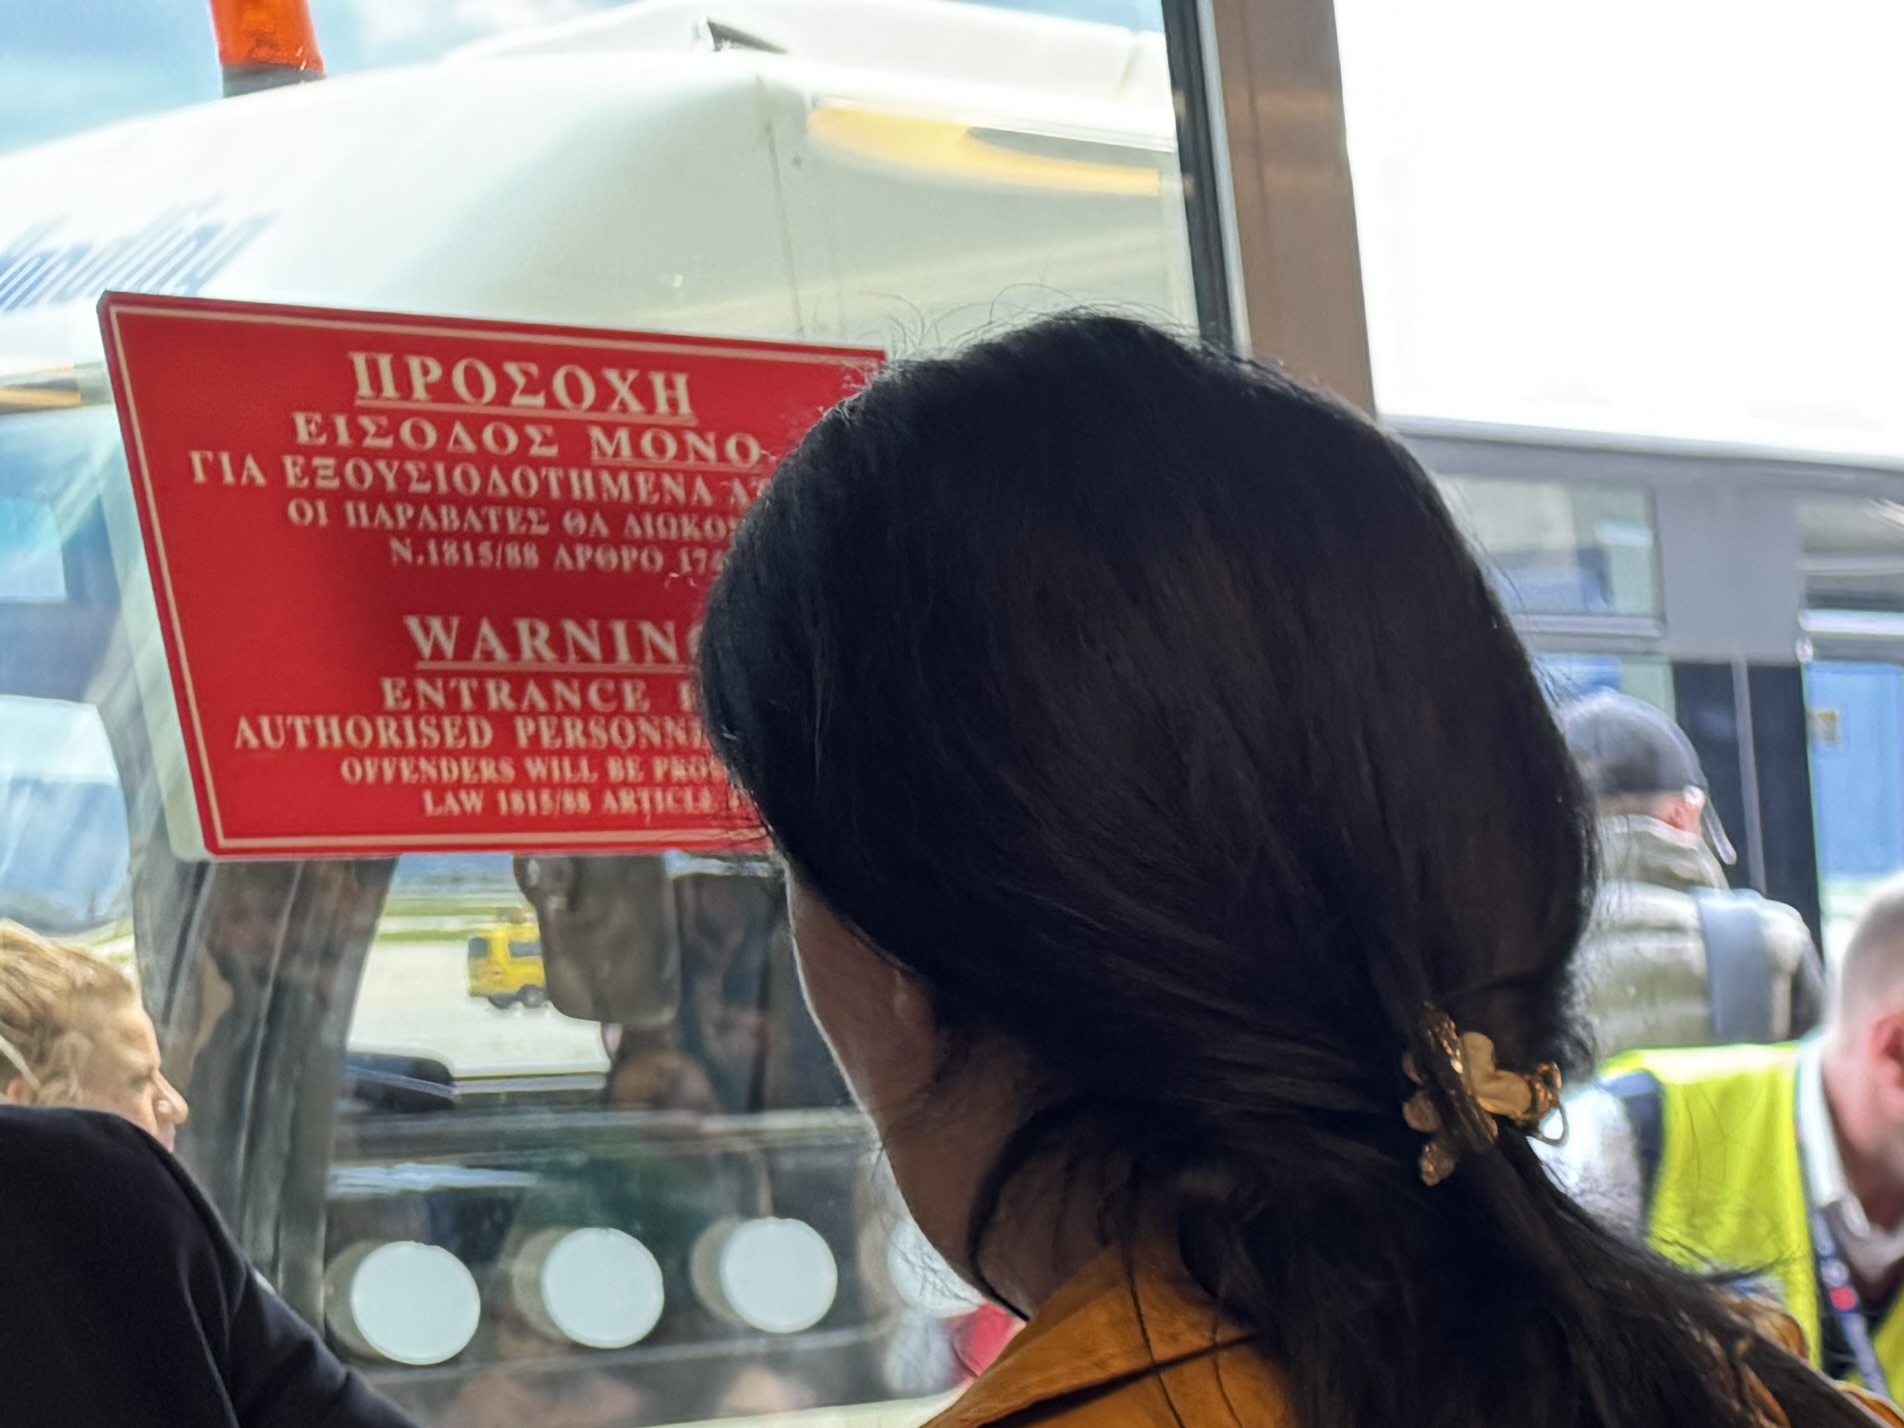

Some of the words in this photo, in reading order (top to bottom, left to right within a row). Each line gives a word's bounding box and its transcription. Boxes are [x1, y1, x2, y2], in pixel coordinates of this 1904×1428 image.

[348, 351, 693, 416] ΠΡΟΣΟΧΗ
[292, 411, 559, 457] ΕΙΣΟΔΟΣ
[588, 425, 762, 468] ΜΟΝΟ
[189, 450, 267, 486] ΓΙΑ
[281, 454, 713, 507] ΕΞΟΥΣΙΟΔΟΤΗΜΕΝΑ
[287, 499, 329, 527] ΟΙ
[344, 500, 549, 536] ΠΑΡΑΒΑΤΕΣ
[562, 508, 609, 538] ΘΑ
[555, 543, 665, 573] ΑΡΘΡΟ
[380, 676, 651, 713] ENTRANCE
[235, 714, 494, 750] AUTHORISED
[340, 756, 515, 784] OFFENDERS
[524, 755, 598, 784] WILL
[606, 755, 646, 783] BE
[423, 789, 484, 817] LAW
[603, 787, 716, 815] ARTICLE
